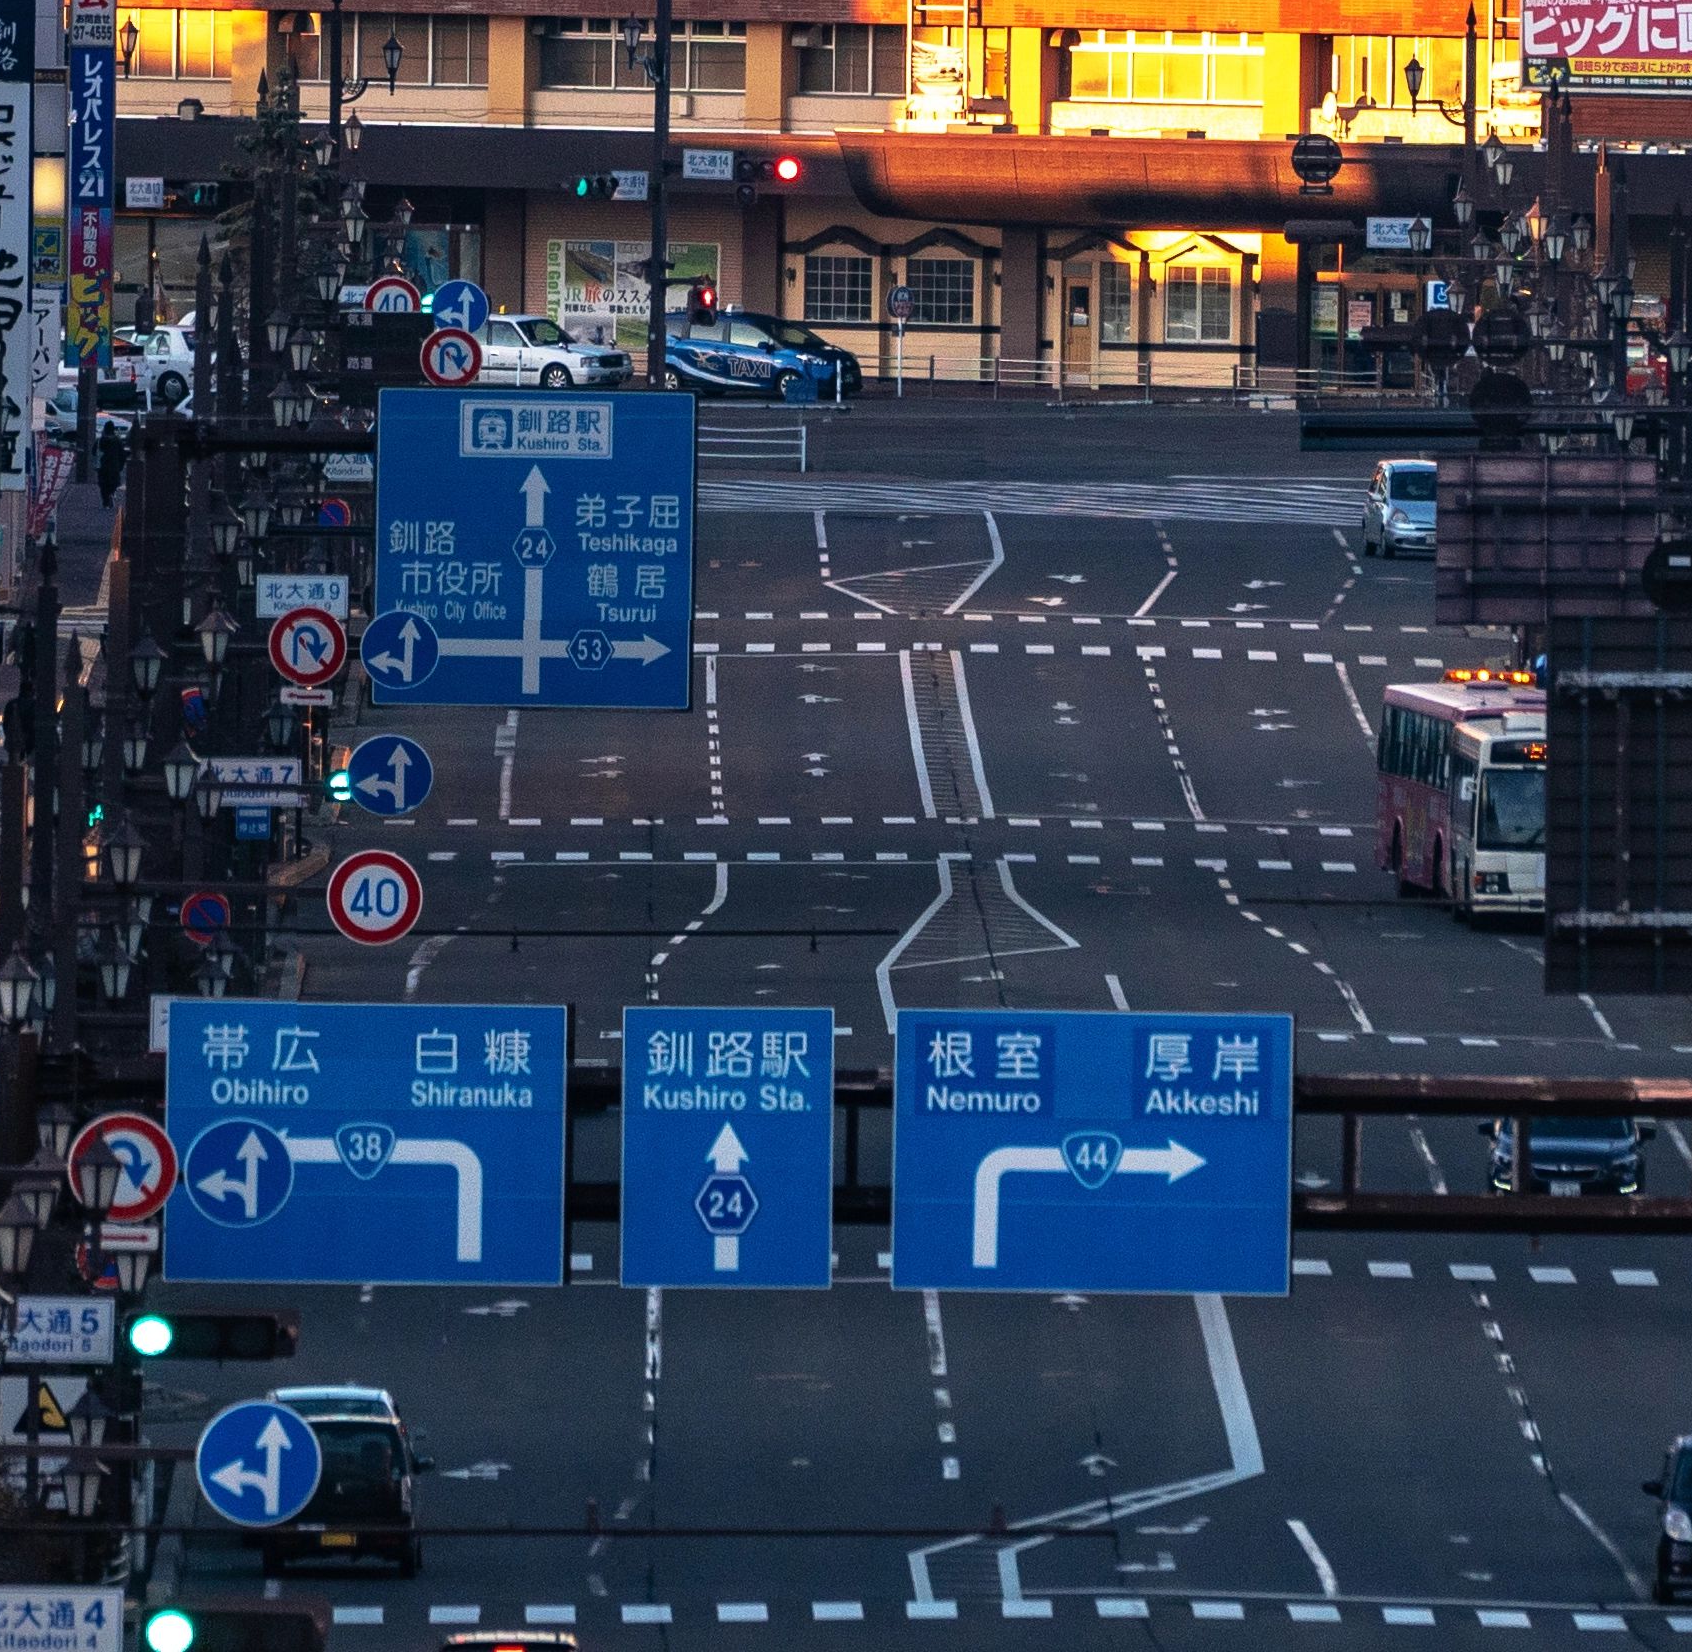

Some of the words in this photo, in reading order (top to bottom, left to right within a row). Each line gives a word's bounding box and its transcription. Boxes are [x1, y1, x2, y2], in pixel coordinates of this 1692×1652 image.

[78, 53, 106, 198] レオパレス21
[31, 308, 51, 382] アーバン
[727, 358, 772, 378] TAXI
[516, 409, 602, 435] 釧路駅
[516, 436, 570, 452] Kushiro
[577, 436, 604, 452] Sta.
[575, 494, 680, 529] 弟子屈
[389, 520, 456, 556] 釧路
[521, 537, 549, 560] 24
[576, 533, 678, 554] Teshikaga
[264, 582, 341, 602] 北大通9
[401, 562, 502, 598] 市役所
[587, 564, 667, 600] 鶴居
[444, 599, 467, 623] City
[472, 599, 507, 622] Office
[596, 603, 657, 624] Tsurui
[576, 637, 602, 662] 53
[350, 878, 400, 918] 40
[202, 1025, 321, 1075] 帯広
[415, 1028, 532, 1078] 白糠
[646, 1031, 811, 1081] 釧路駅
[927, 1032, 1042, 1081] 根室
[1145, 1033, 1260, 1083] 厚岸
[211, 1078, 310, 1106] Obihiro
[410, 1081, 534, 1109] Shiranuka
[643, 1085, 747, 1111] Kushiro
[759, 1085, 812, 1112] Sta.
[926, 1088, 1042, 1114] Nemuro
[1144, 1088, 1259, 1116] Akkeshi
[349, 1134, 382, 1162] 38
[1074, 1144, 1109, 1170] 44
[708, 1192, 744, 1220] 24
[0, 1307, 100, 1336] 大通5
